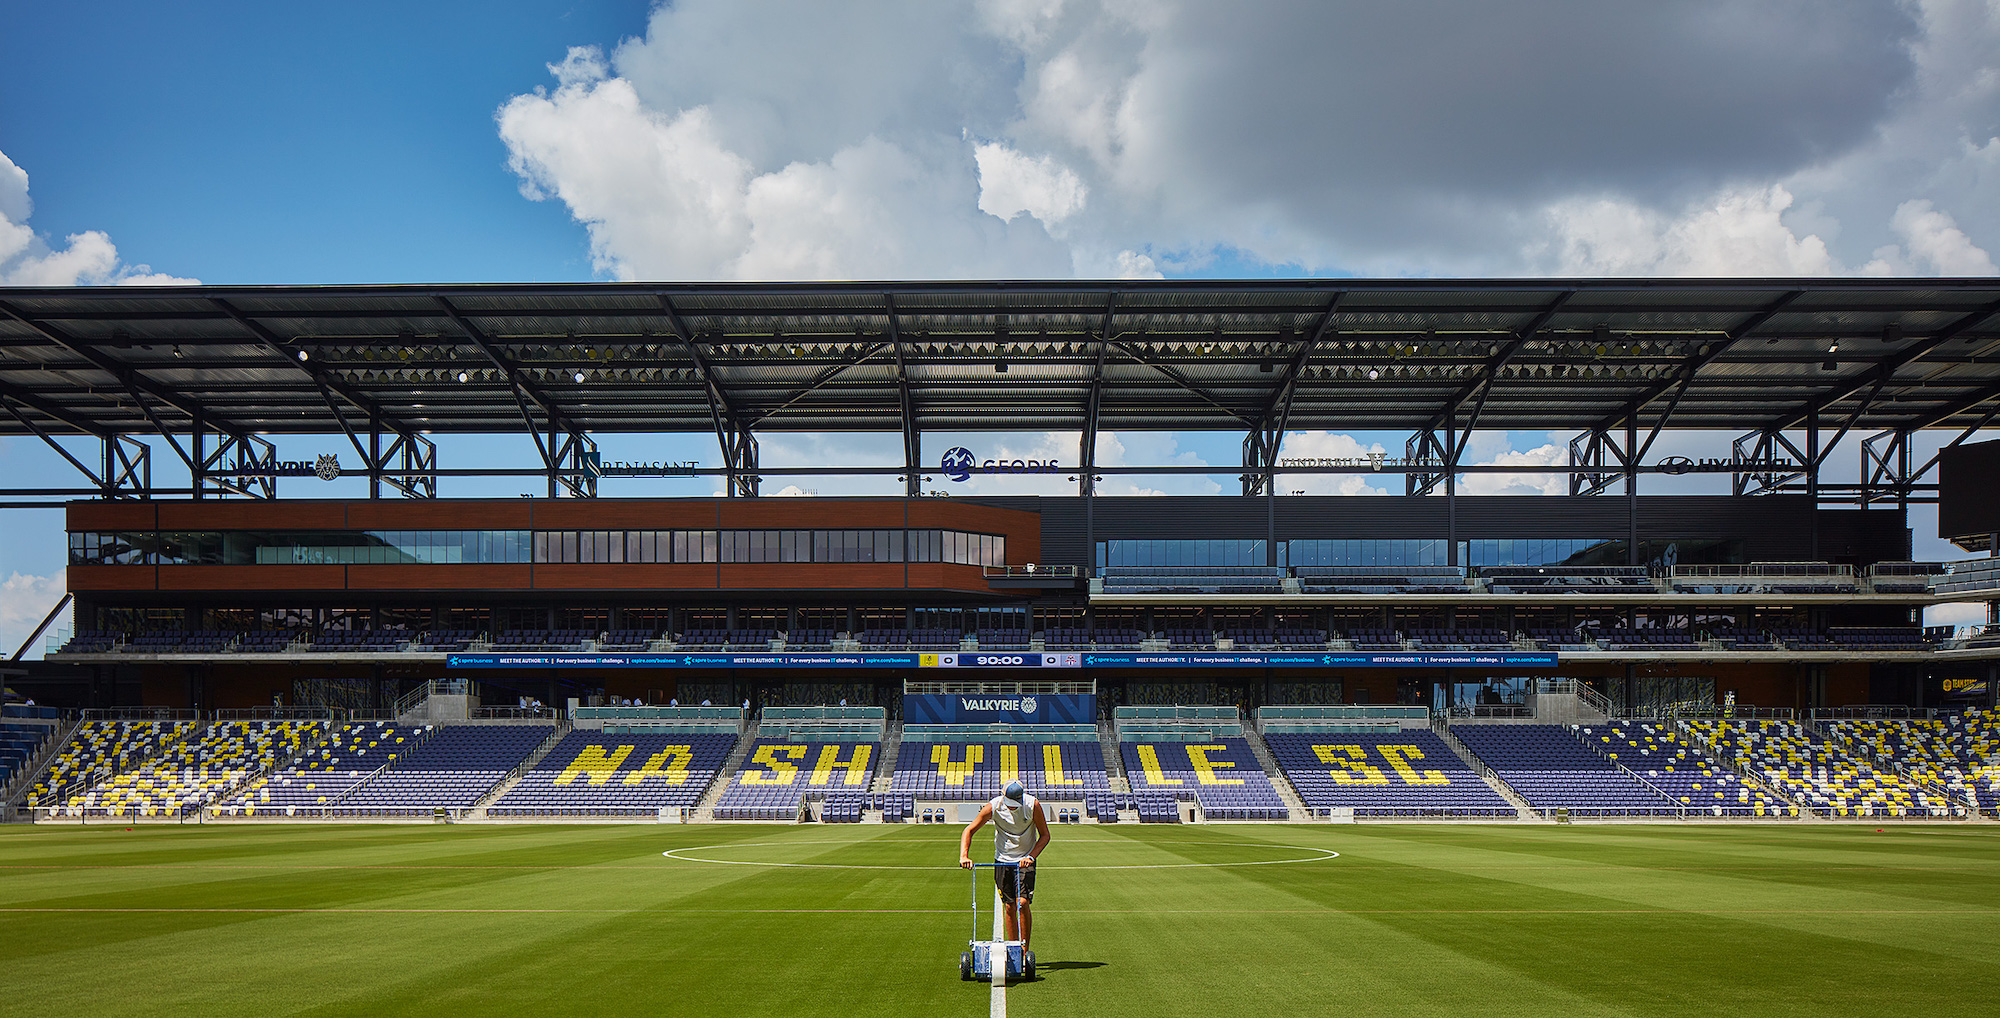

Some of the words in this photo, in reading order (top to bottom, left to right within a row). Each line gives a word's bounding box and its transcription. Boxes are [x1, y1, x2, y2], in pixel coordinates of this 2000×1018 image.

[602, 461, 699, 474] RENASANT
[982, 459, 1059, 474] GEODIS
[1281, 458, 1362, 468] VANDERBILT
[1391, 457, 1442, 467] HEALTH
[976, 656, 1023, 665] 90:00
[1953, 679, 1964, 689] TEAM
[962, 698, 1019, 710] VALKYRIE
